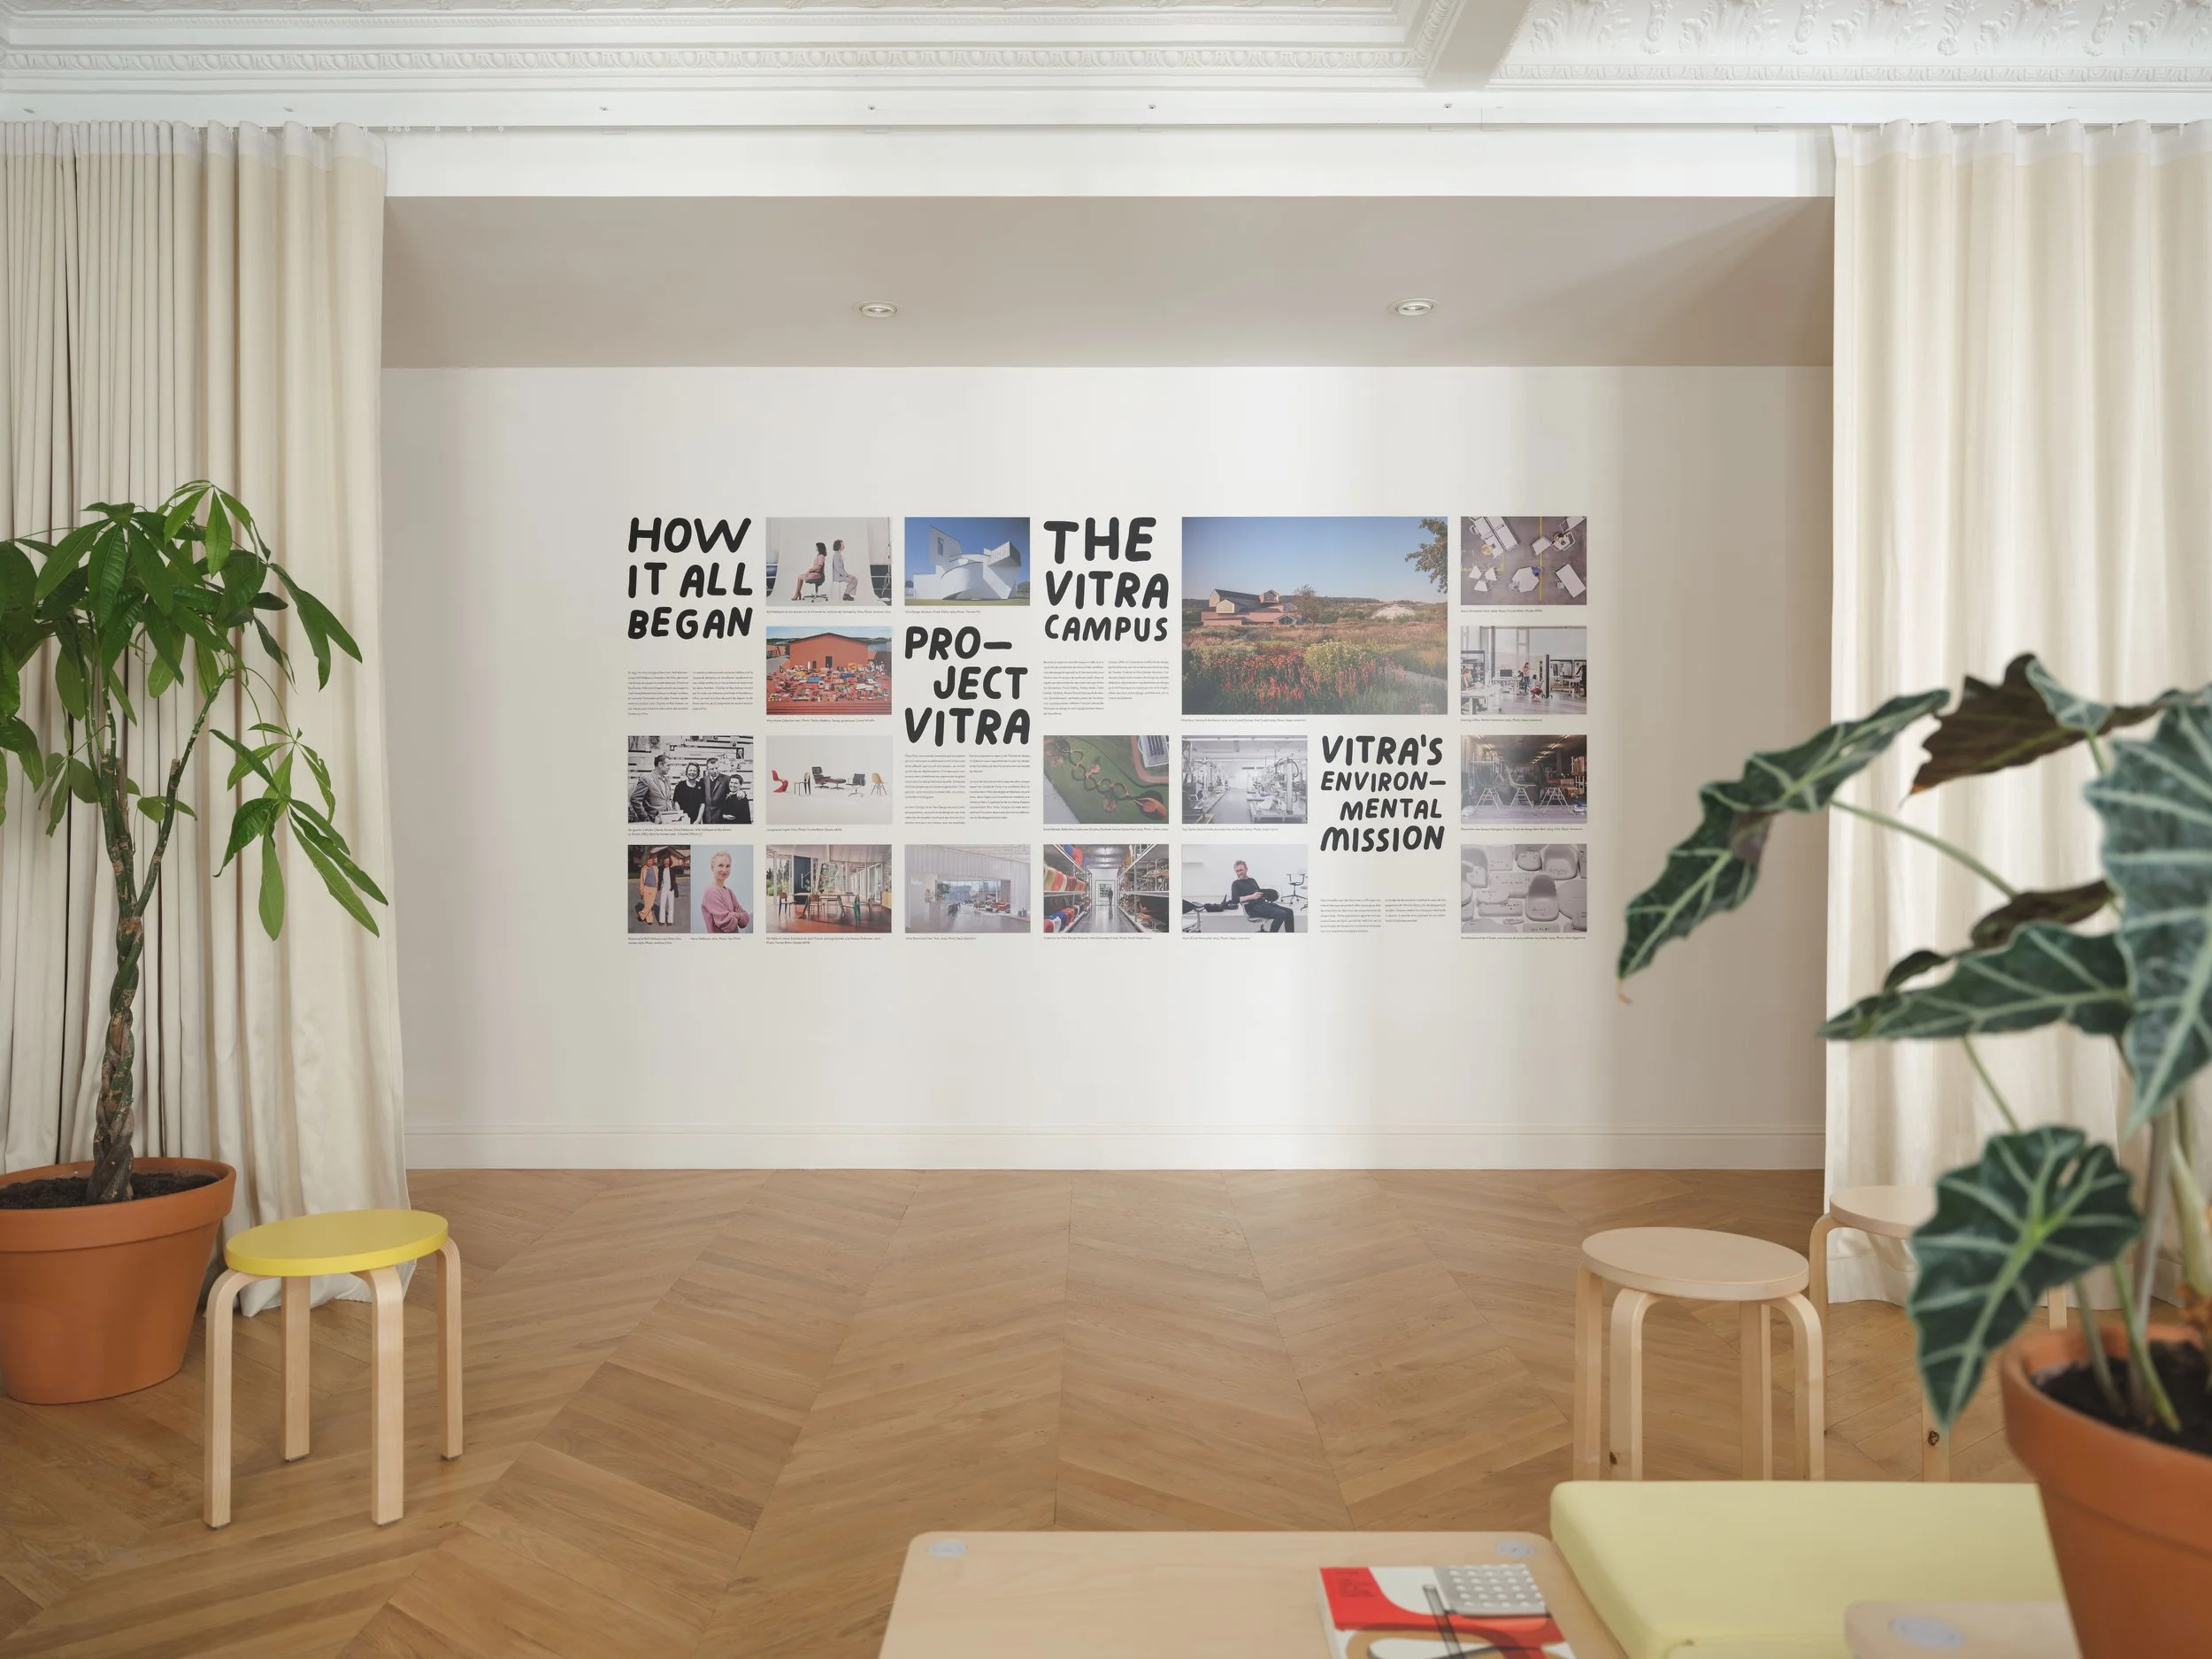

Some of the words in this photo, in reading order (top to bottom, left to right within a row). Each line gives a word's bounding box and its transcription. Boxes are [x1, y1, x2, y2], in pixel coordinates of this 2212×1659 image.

[627, 517, 752, 554] HOW
[1043, 517, 1156, 565] THE
[627, 562, 668, 599] IT
[679, 562, 753, 598] ALL
[1045, 570, 1169, 610] VITRA
[627, 606, 753, 640] BEGAN
[1044, 614, 1168, 642] CAMPUS
[933, 665, 1028, 701] JECT
[904, 707, 1031, 748] VITRA
[1322, 733, 1443, 766] VITRA'S
[1340, 797, 1442, 821] MENTAL
[1320, 825, 1445, 852] MISSION
